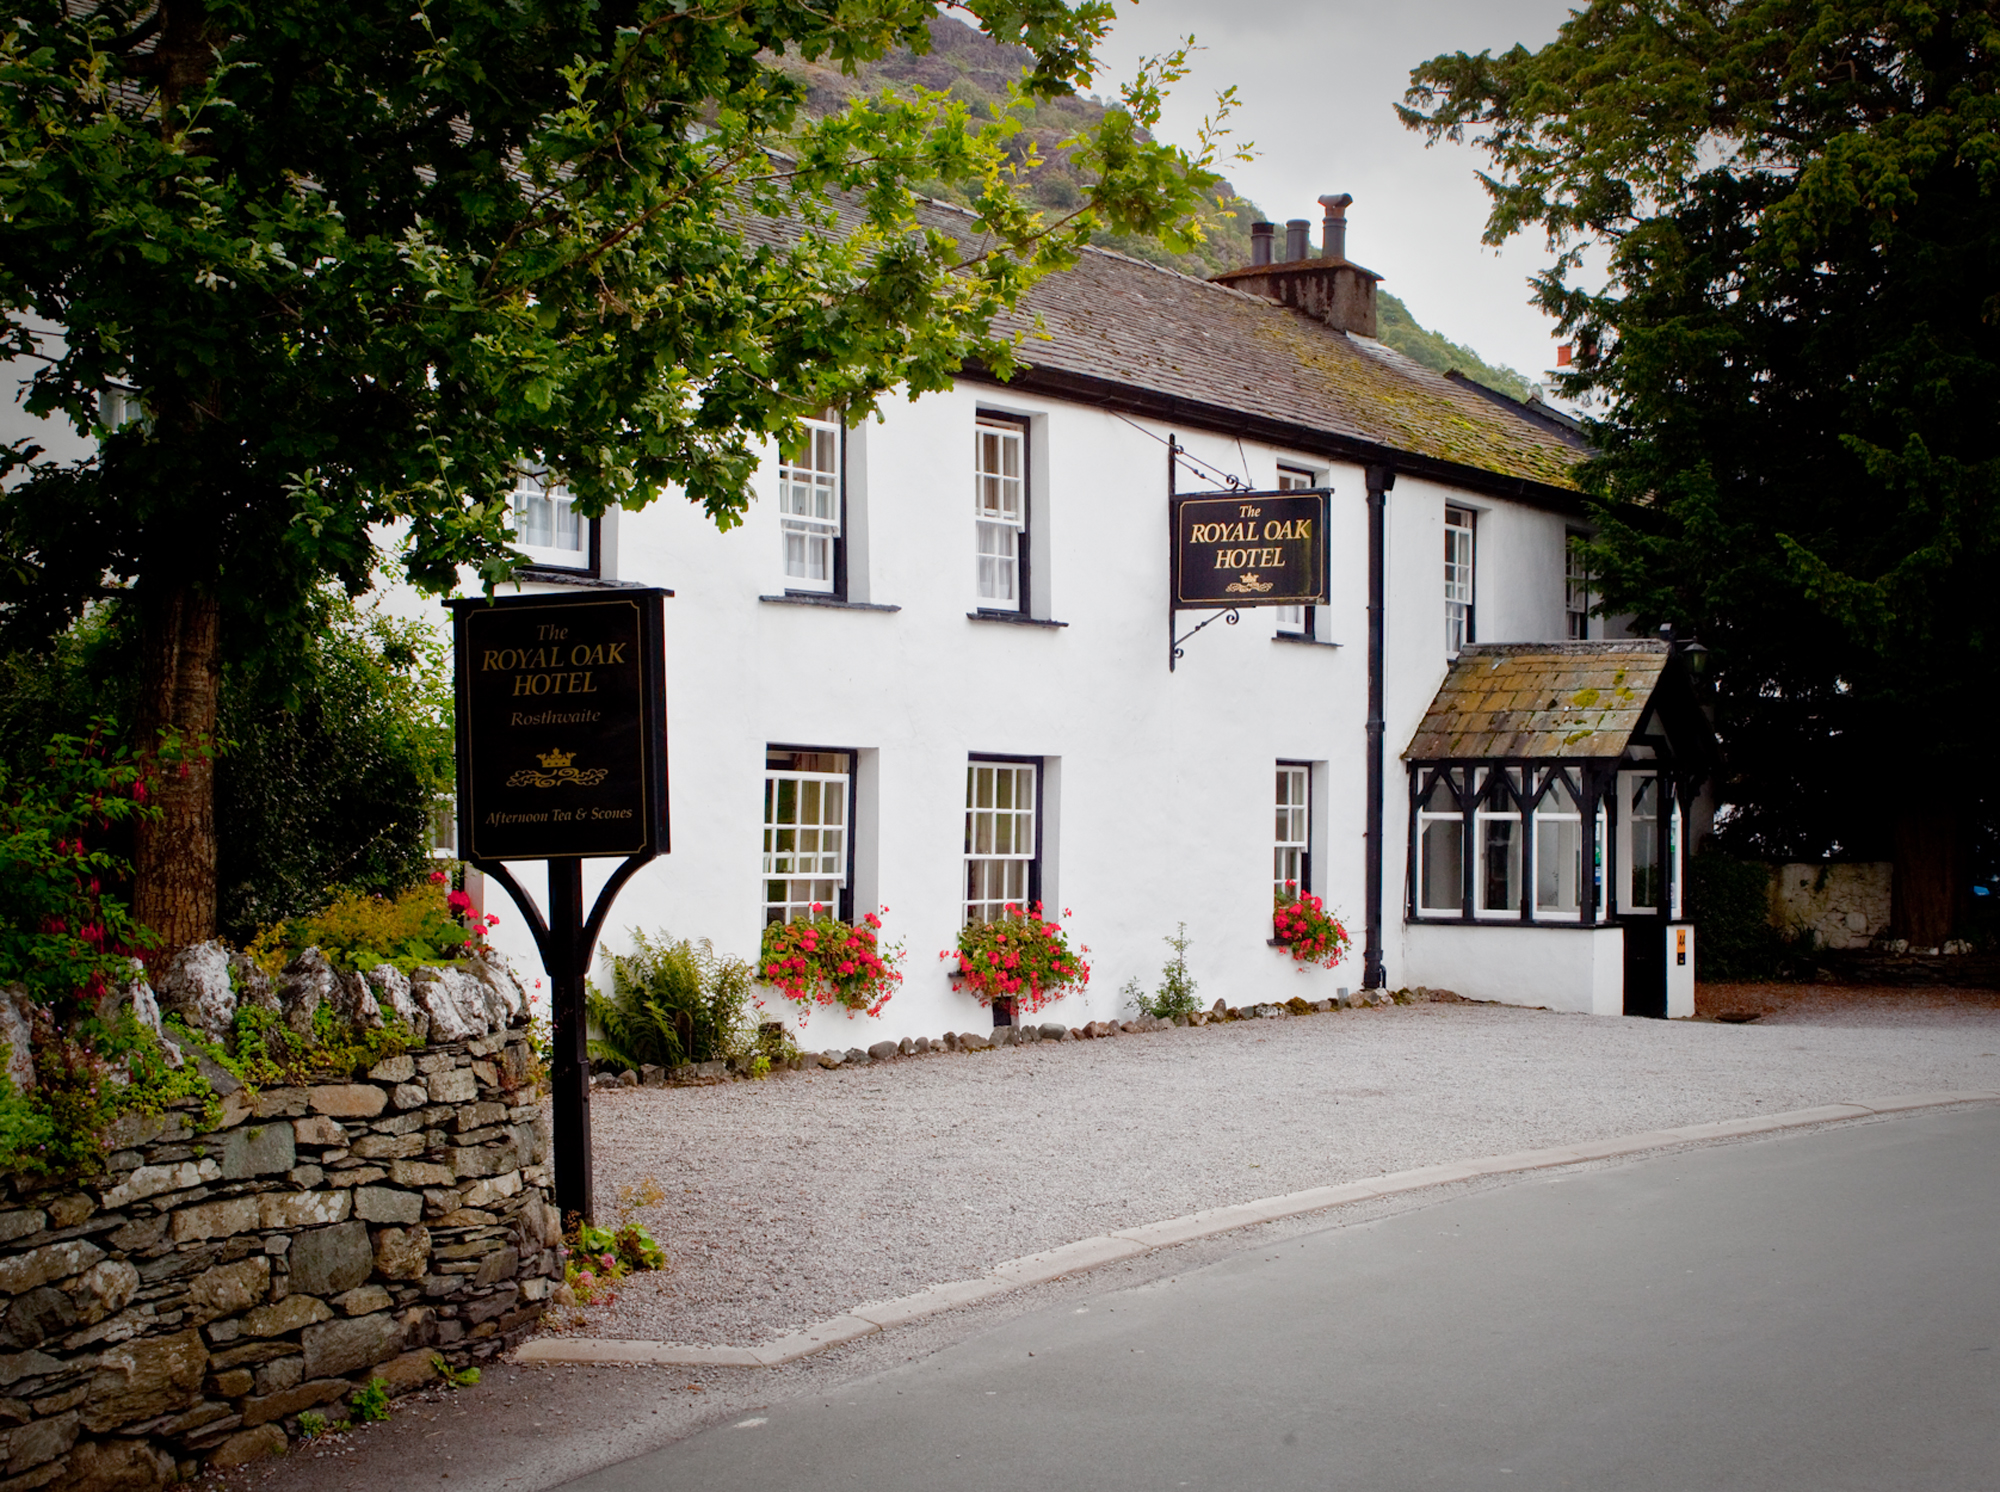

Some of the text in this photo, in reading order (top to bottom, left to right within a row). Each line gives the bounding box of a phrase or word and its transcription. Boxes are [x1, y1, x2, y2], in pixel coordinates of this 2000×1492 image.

[1239, 505, 1261, 518] The
[1190, 519, 1312, 543] ROYAL OAK
[1214, 547, 1285, 569] HOTEL
[536, 624, 569, 641] The
[481, 642, 626, 671] ROYAL OAK
[512, 671, 598, 696] HOTEL
[510, 709, 601, 726] Rosthwaite
[485, 807, 633, 827] Afternoon Tea & Scones
